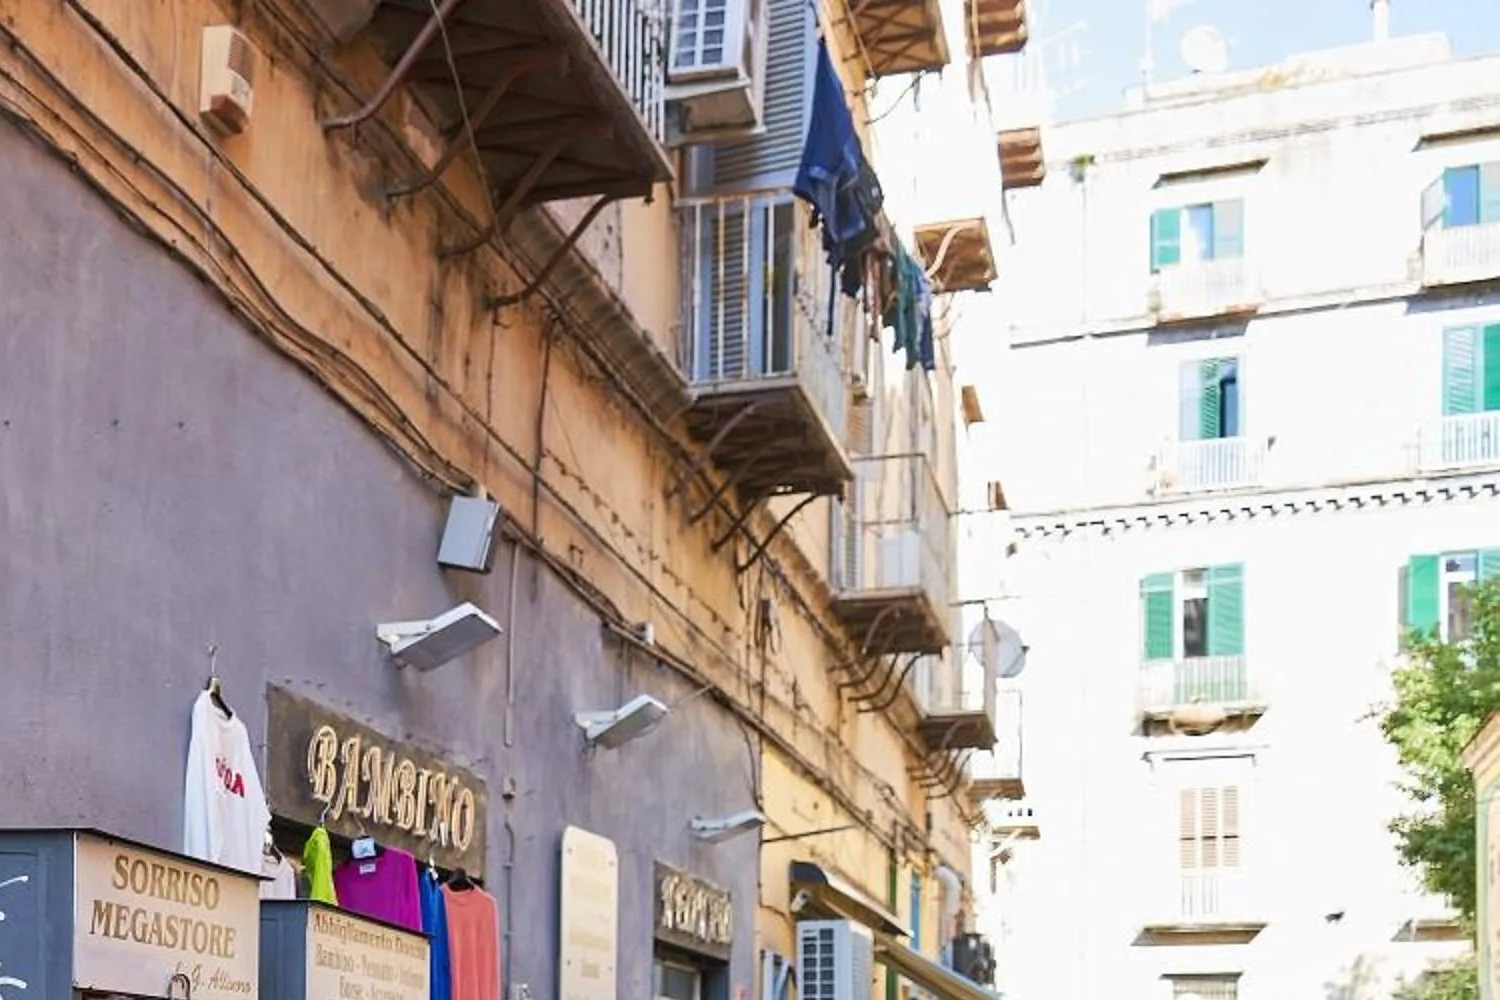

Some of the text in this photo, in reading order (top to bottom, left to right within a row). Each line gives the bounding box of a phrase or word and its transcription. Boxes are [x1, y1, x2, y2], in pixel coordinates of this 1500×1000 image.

[307, 725, 475, 851] BAMBINO
[112, 854, 220, 910] SORRISO
[89, 899, 237, 959] MEGASTORE
